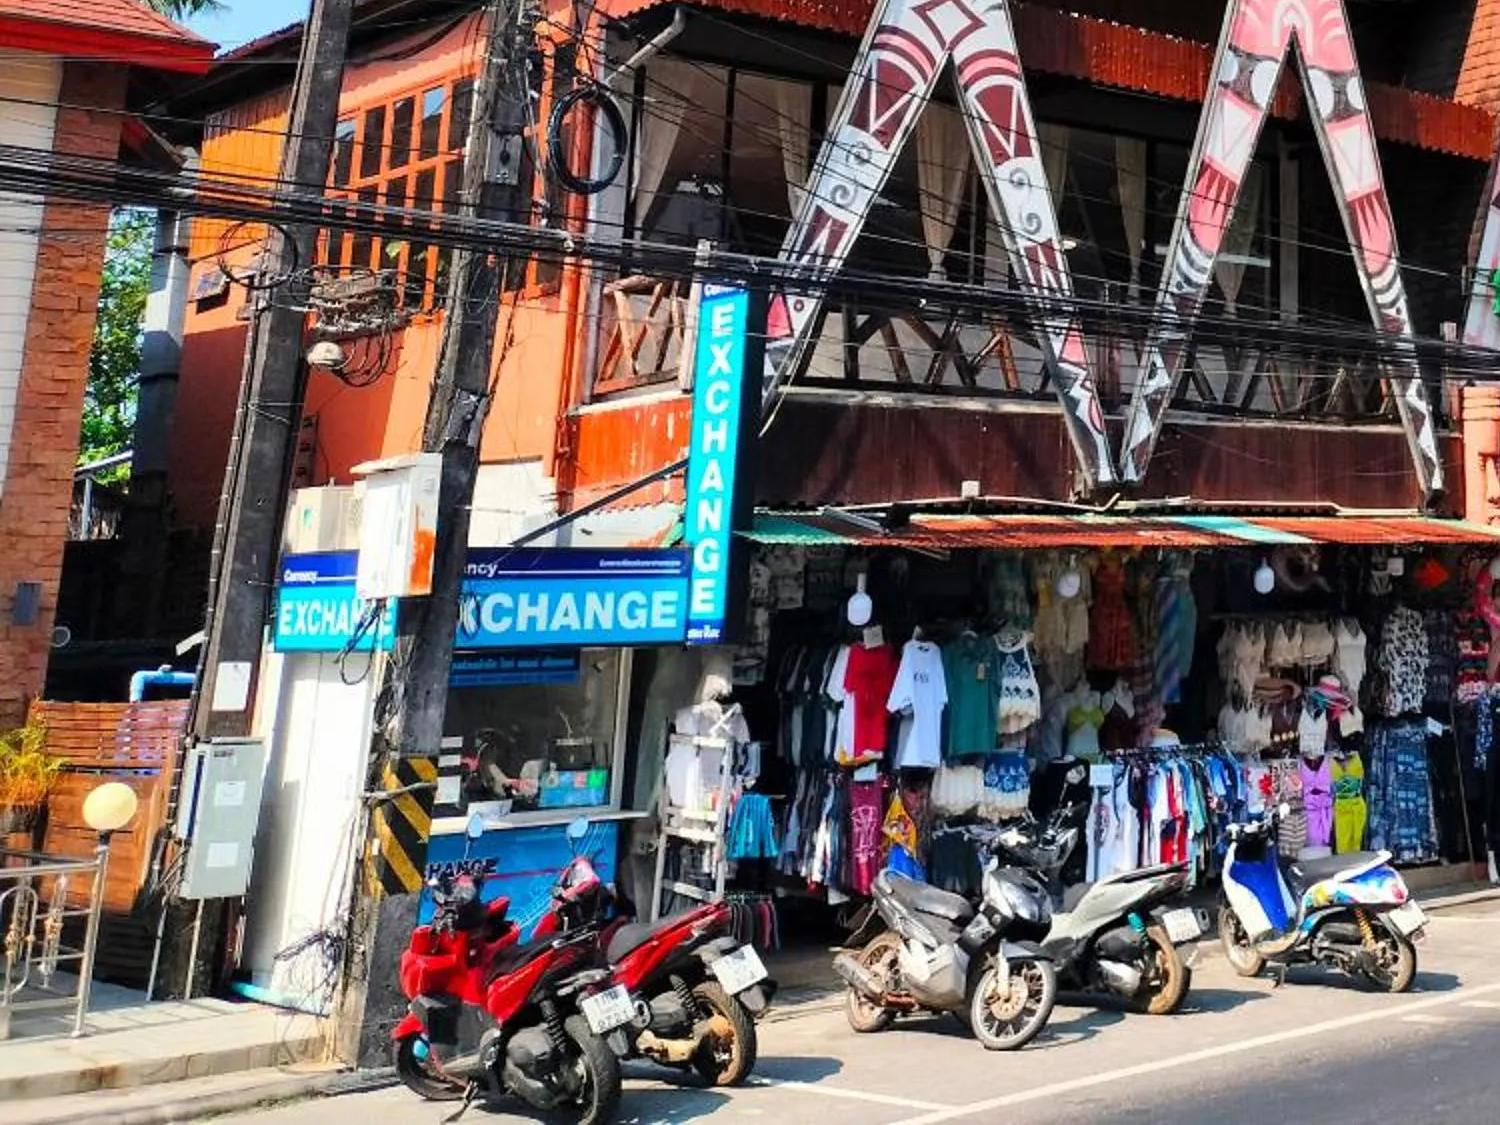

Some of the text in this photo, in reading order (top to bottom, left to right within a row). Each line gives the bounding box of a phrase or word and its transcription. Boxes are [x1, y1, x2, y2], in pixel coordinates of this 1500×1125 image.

[691, 302, 736, 614] EXCHANGE
[279, 596, 394, 636] EXCHANE
[459, 590, 679, 633] XCHANGE
